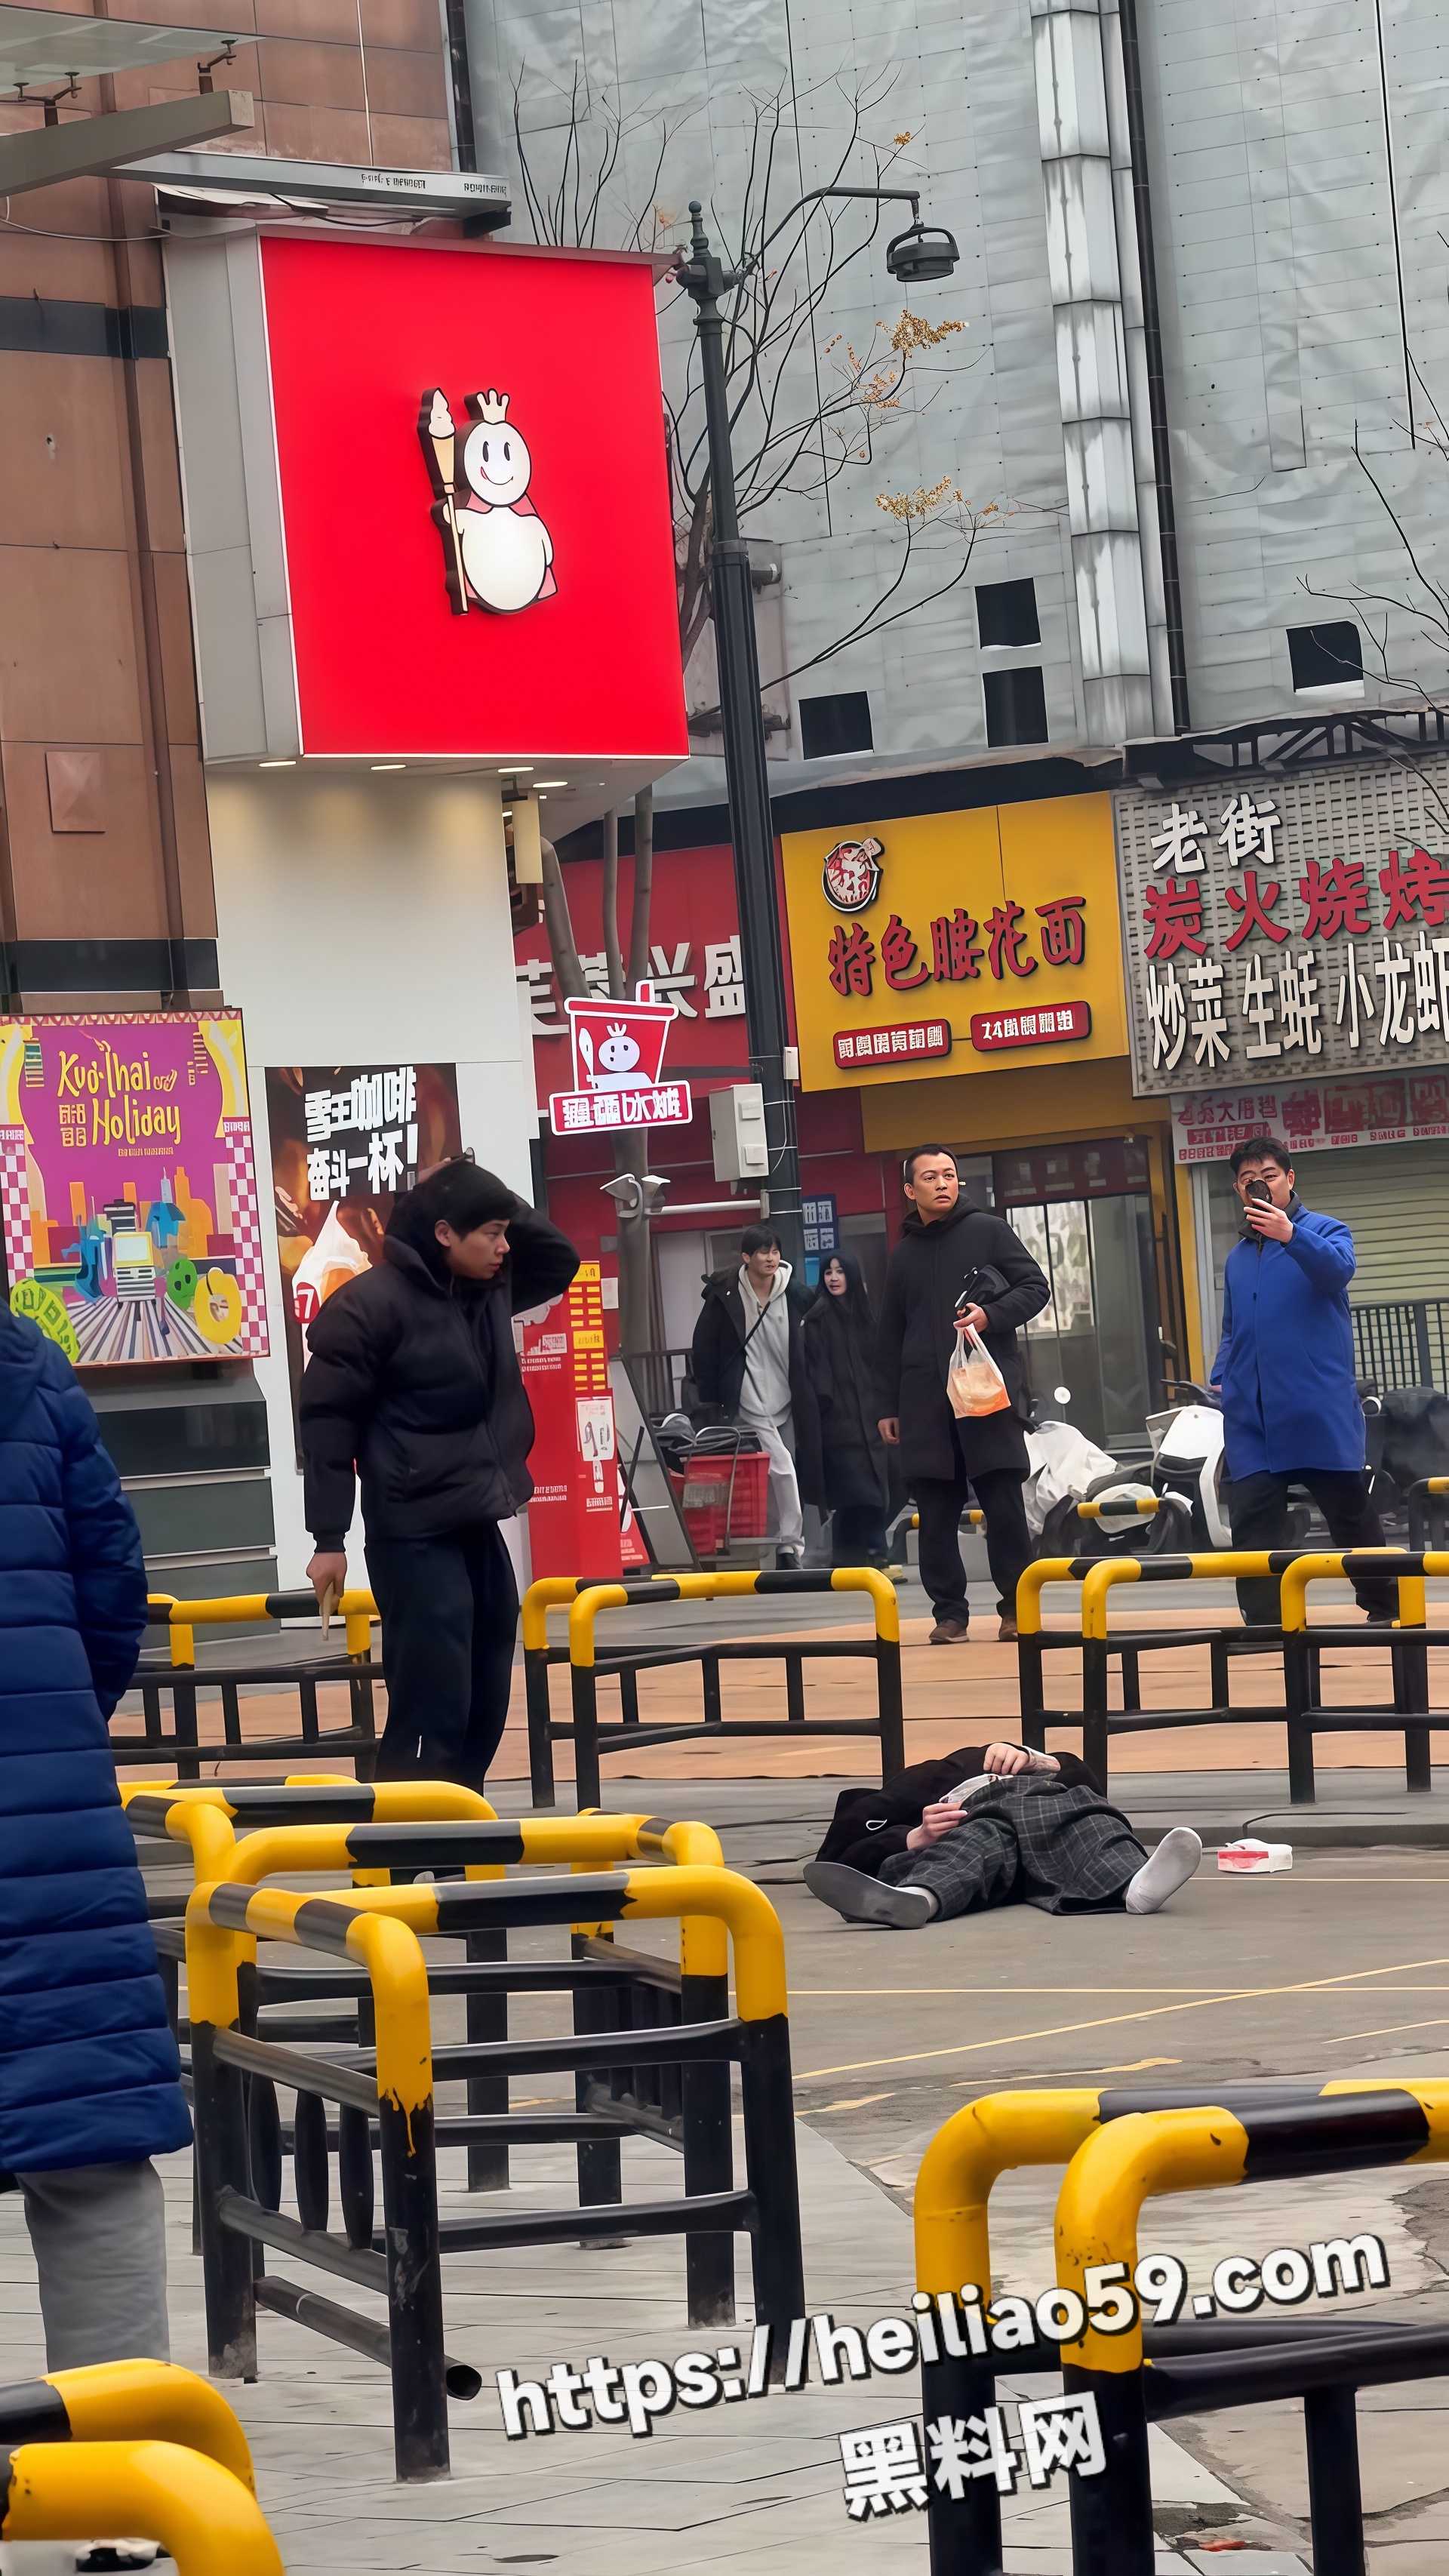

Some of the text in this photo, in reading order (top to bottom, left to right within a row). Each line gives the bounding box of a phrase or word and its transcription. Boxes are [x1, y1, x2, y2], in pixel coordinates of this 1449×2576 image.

[1150, 792, 1281, 873] 老街
[1143, 849, 1449, 959] 炭火烧烤
[1146, 931, 1449, 1069] 炒菜 生蚝 小龙虾
[92, 1094, 181, 1145] Holiday
[305, 1066, 417, 1143] 雪王咖啡
